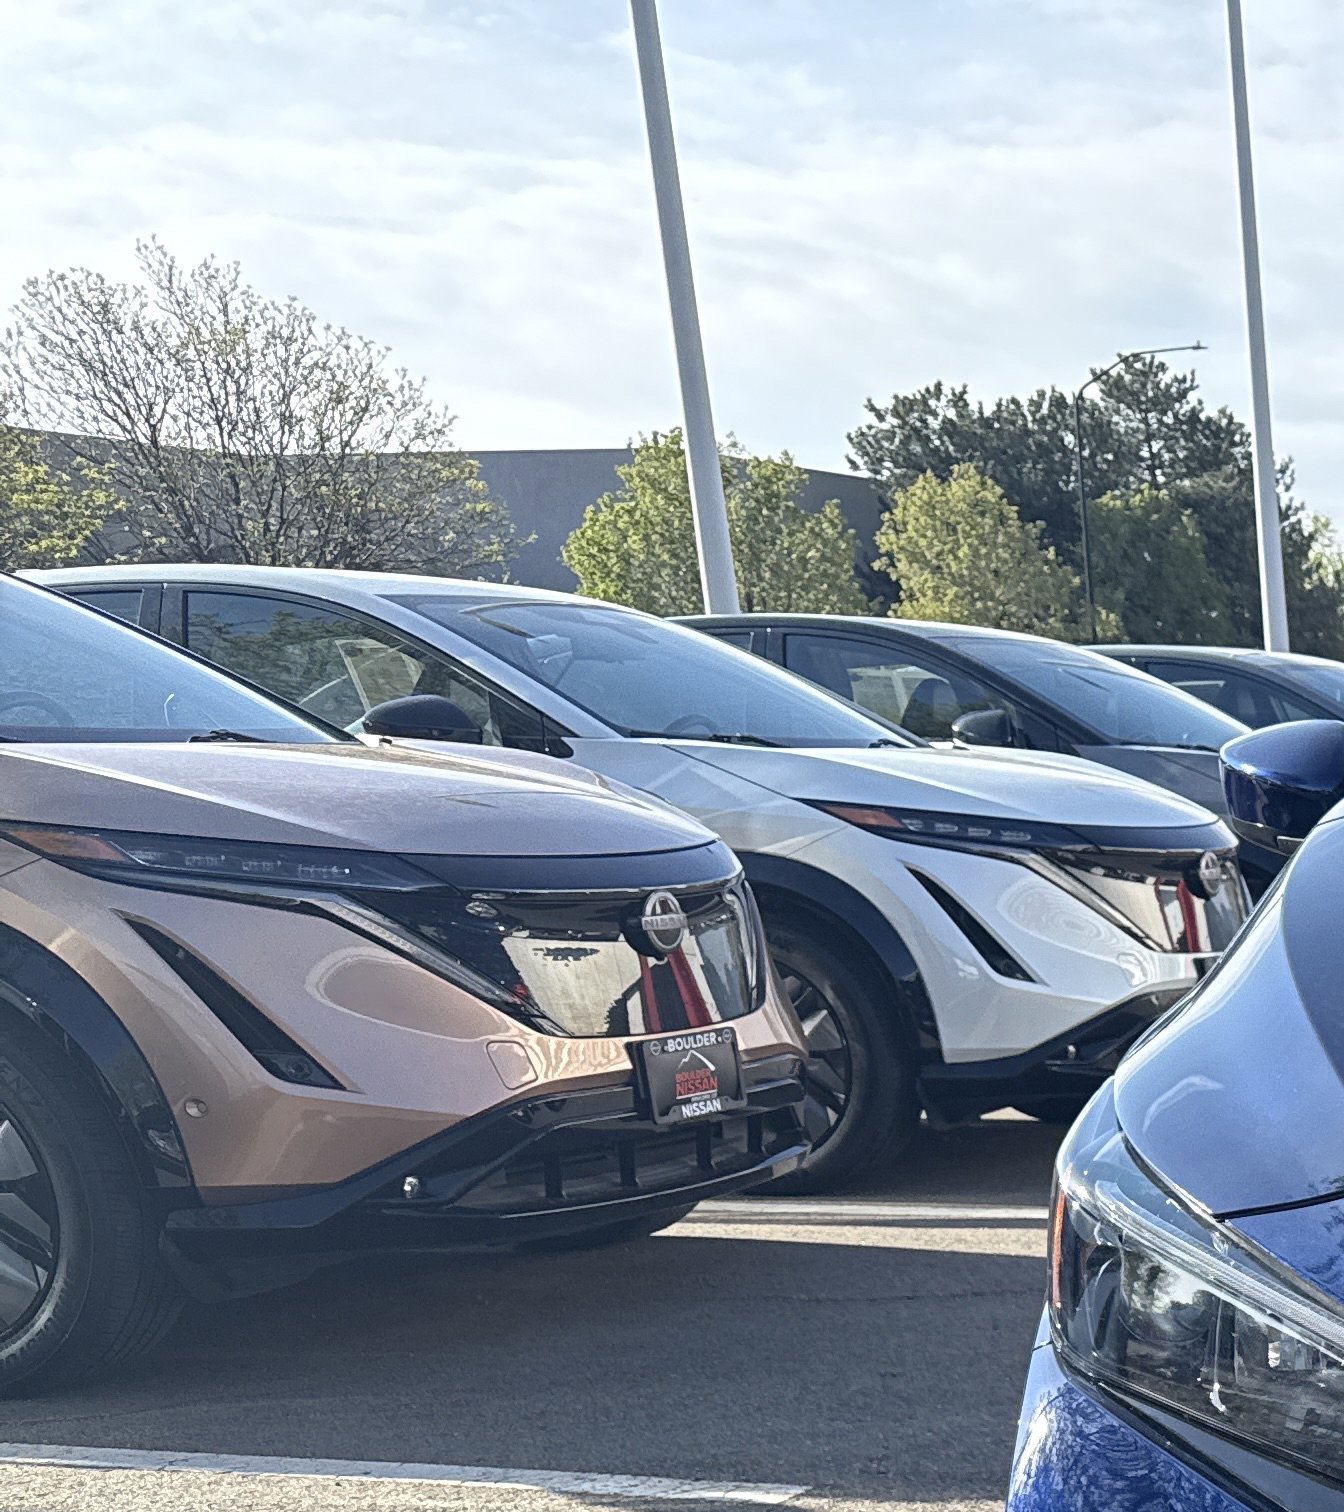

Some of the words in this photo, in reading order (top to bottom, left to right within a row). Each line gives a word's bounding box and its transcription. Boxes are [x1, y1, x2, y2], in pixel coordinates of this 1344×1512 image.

[667, 1032, 717, 1053] BOULDER
[675, 1068, 712, 1083] BOULDER
[676, 1077, 718, 1097] NISSAN
[681, 1098, 722, 1119] NISSAN
